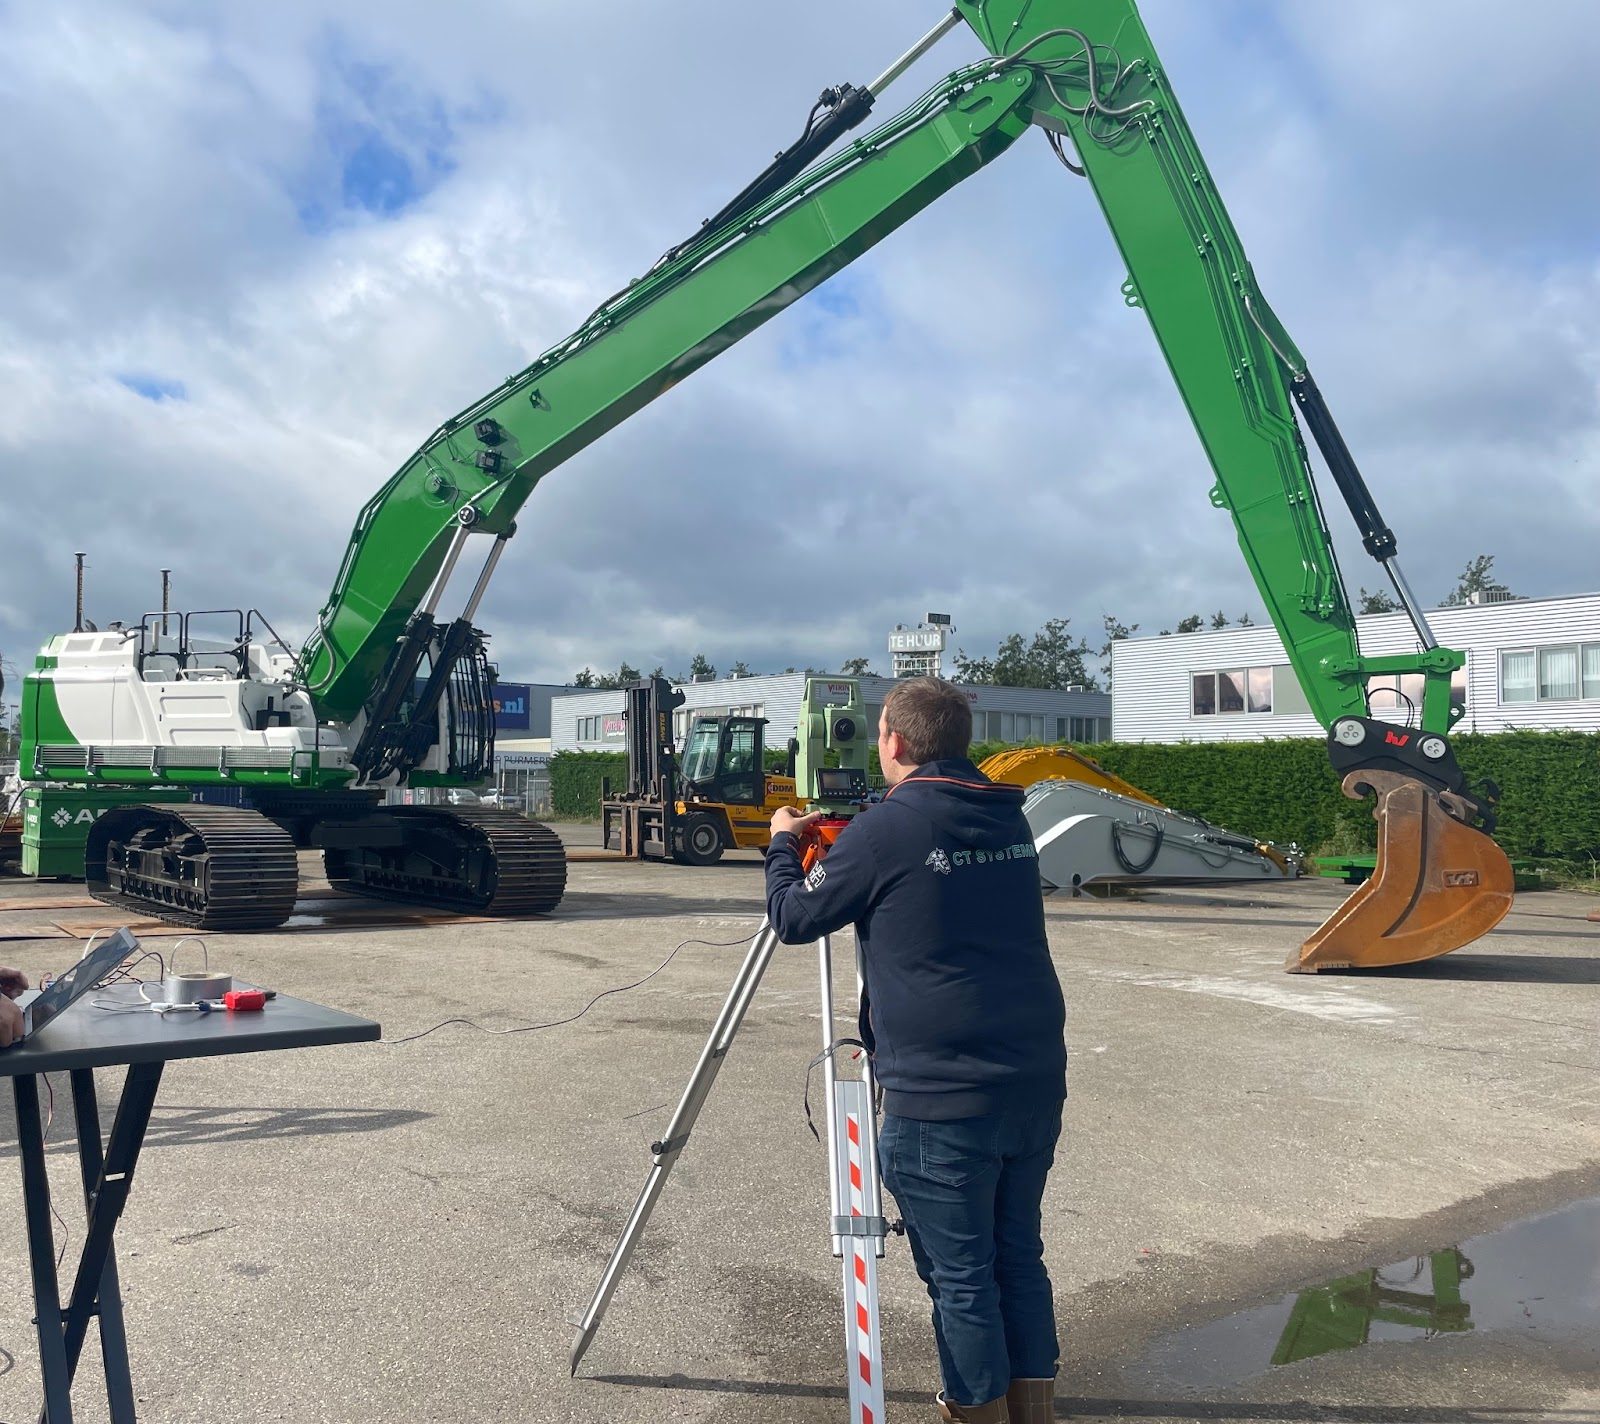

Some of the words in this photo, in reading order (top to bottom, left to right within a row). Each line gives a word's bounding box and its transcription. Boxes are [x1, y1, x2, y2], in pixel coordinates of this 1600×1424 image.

[890, 635, 904, 649] TE
[906, 634, 941, 648] HUUR
[952, 850, 972, 866] CT
